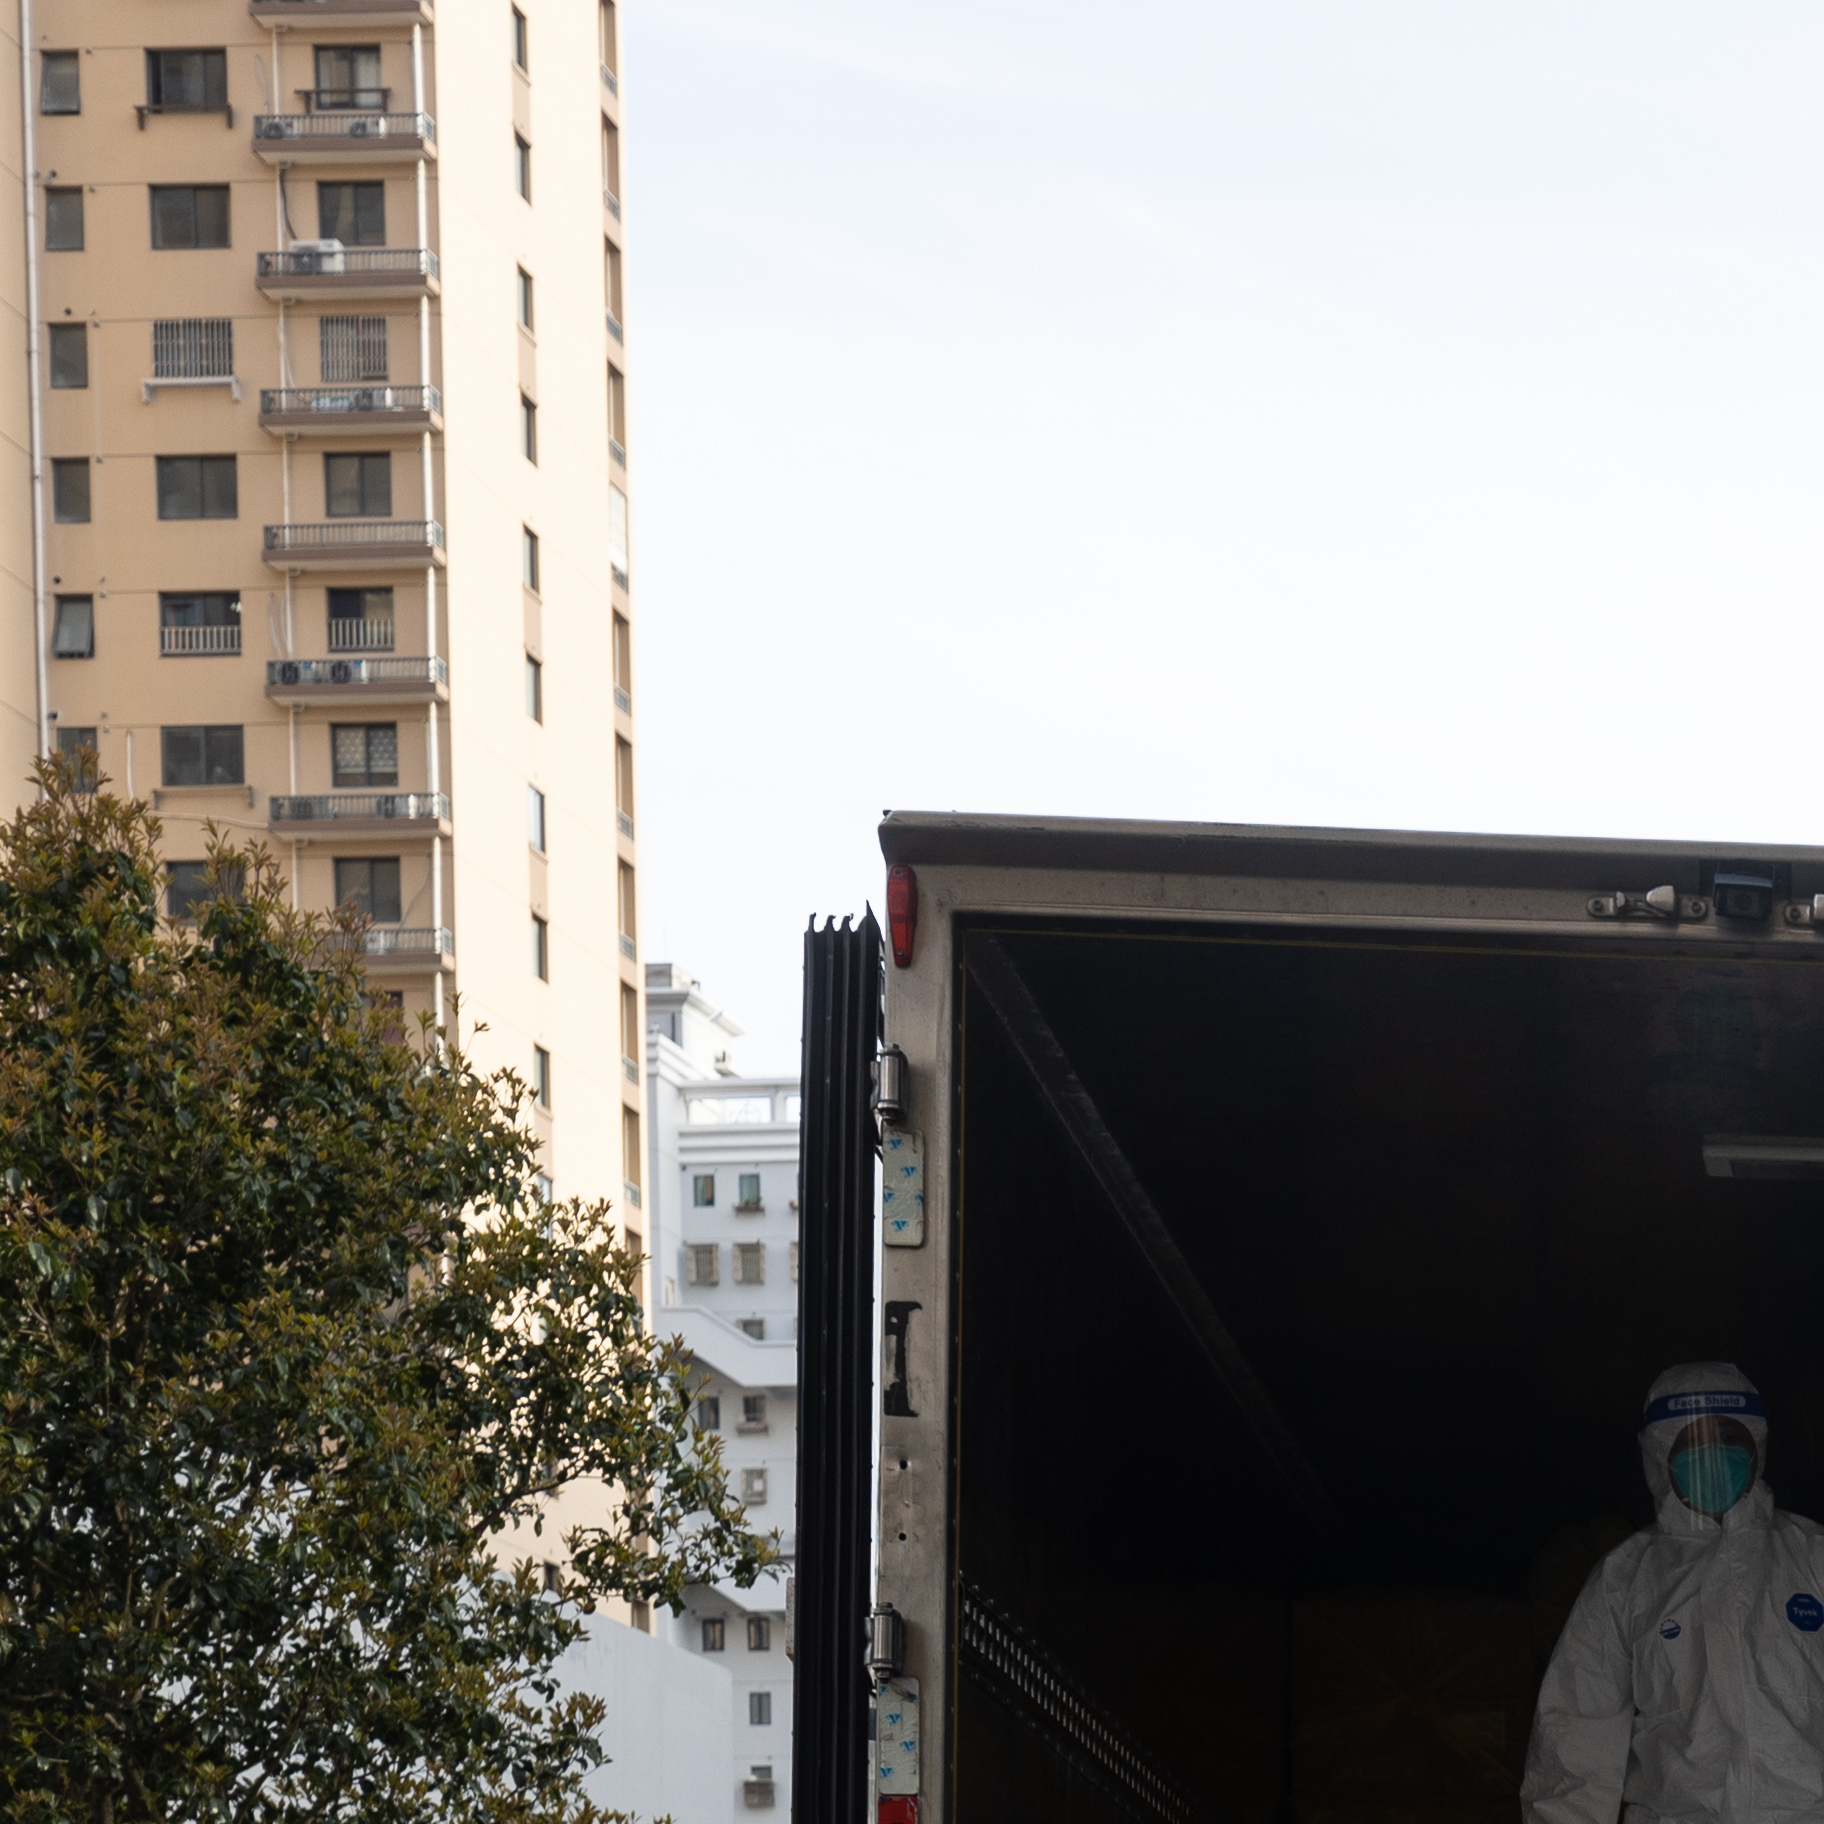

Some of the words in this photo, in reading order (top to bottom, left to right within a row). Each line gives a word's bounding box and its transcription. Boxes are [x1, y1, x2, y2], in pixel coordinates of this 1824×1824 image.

[1673, 1398, 1701, 1409] Face
[1704, 1396, 1741, 1407] Shield
[1792, 1606, 1818, 1618] Tyvek
